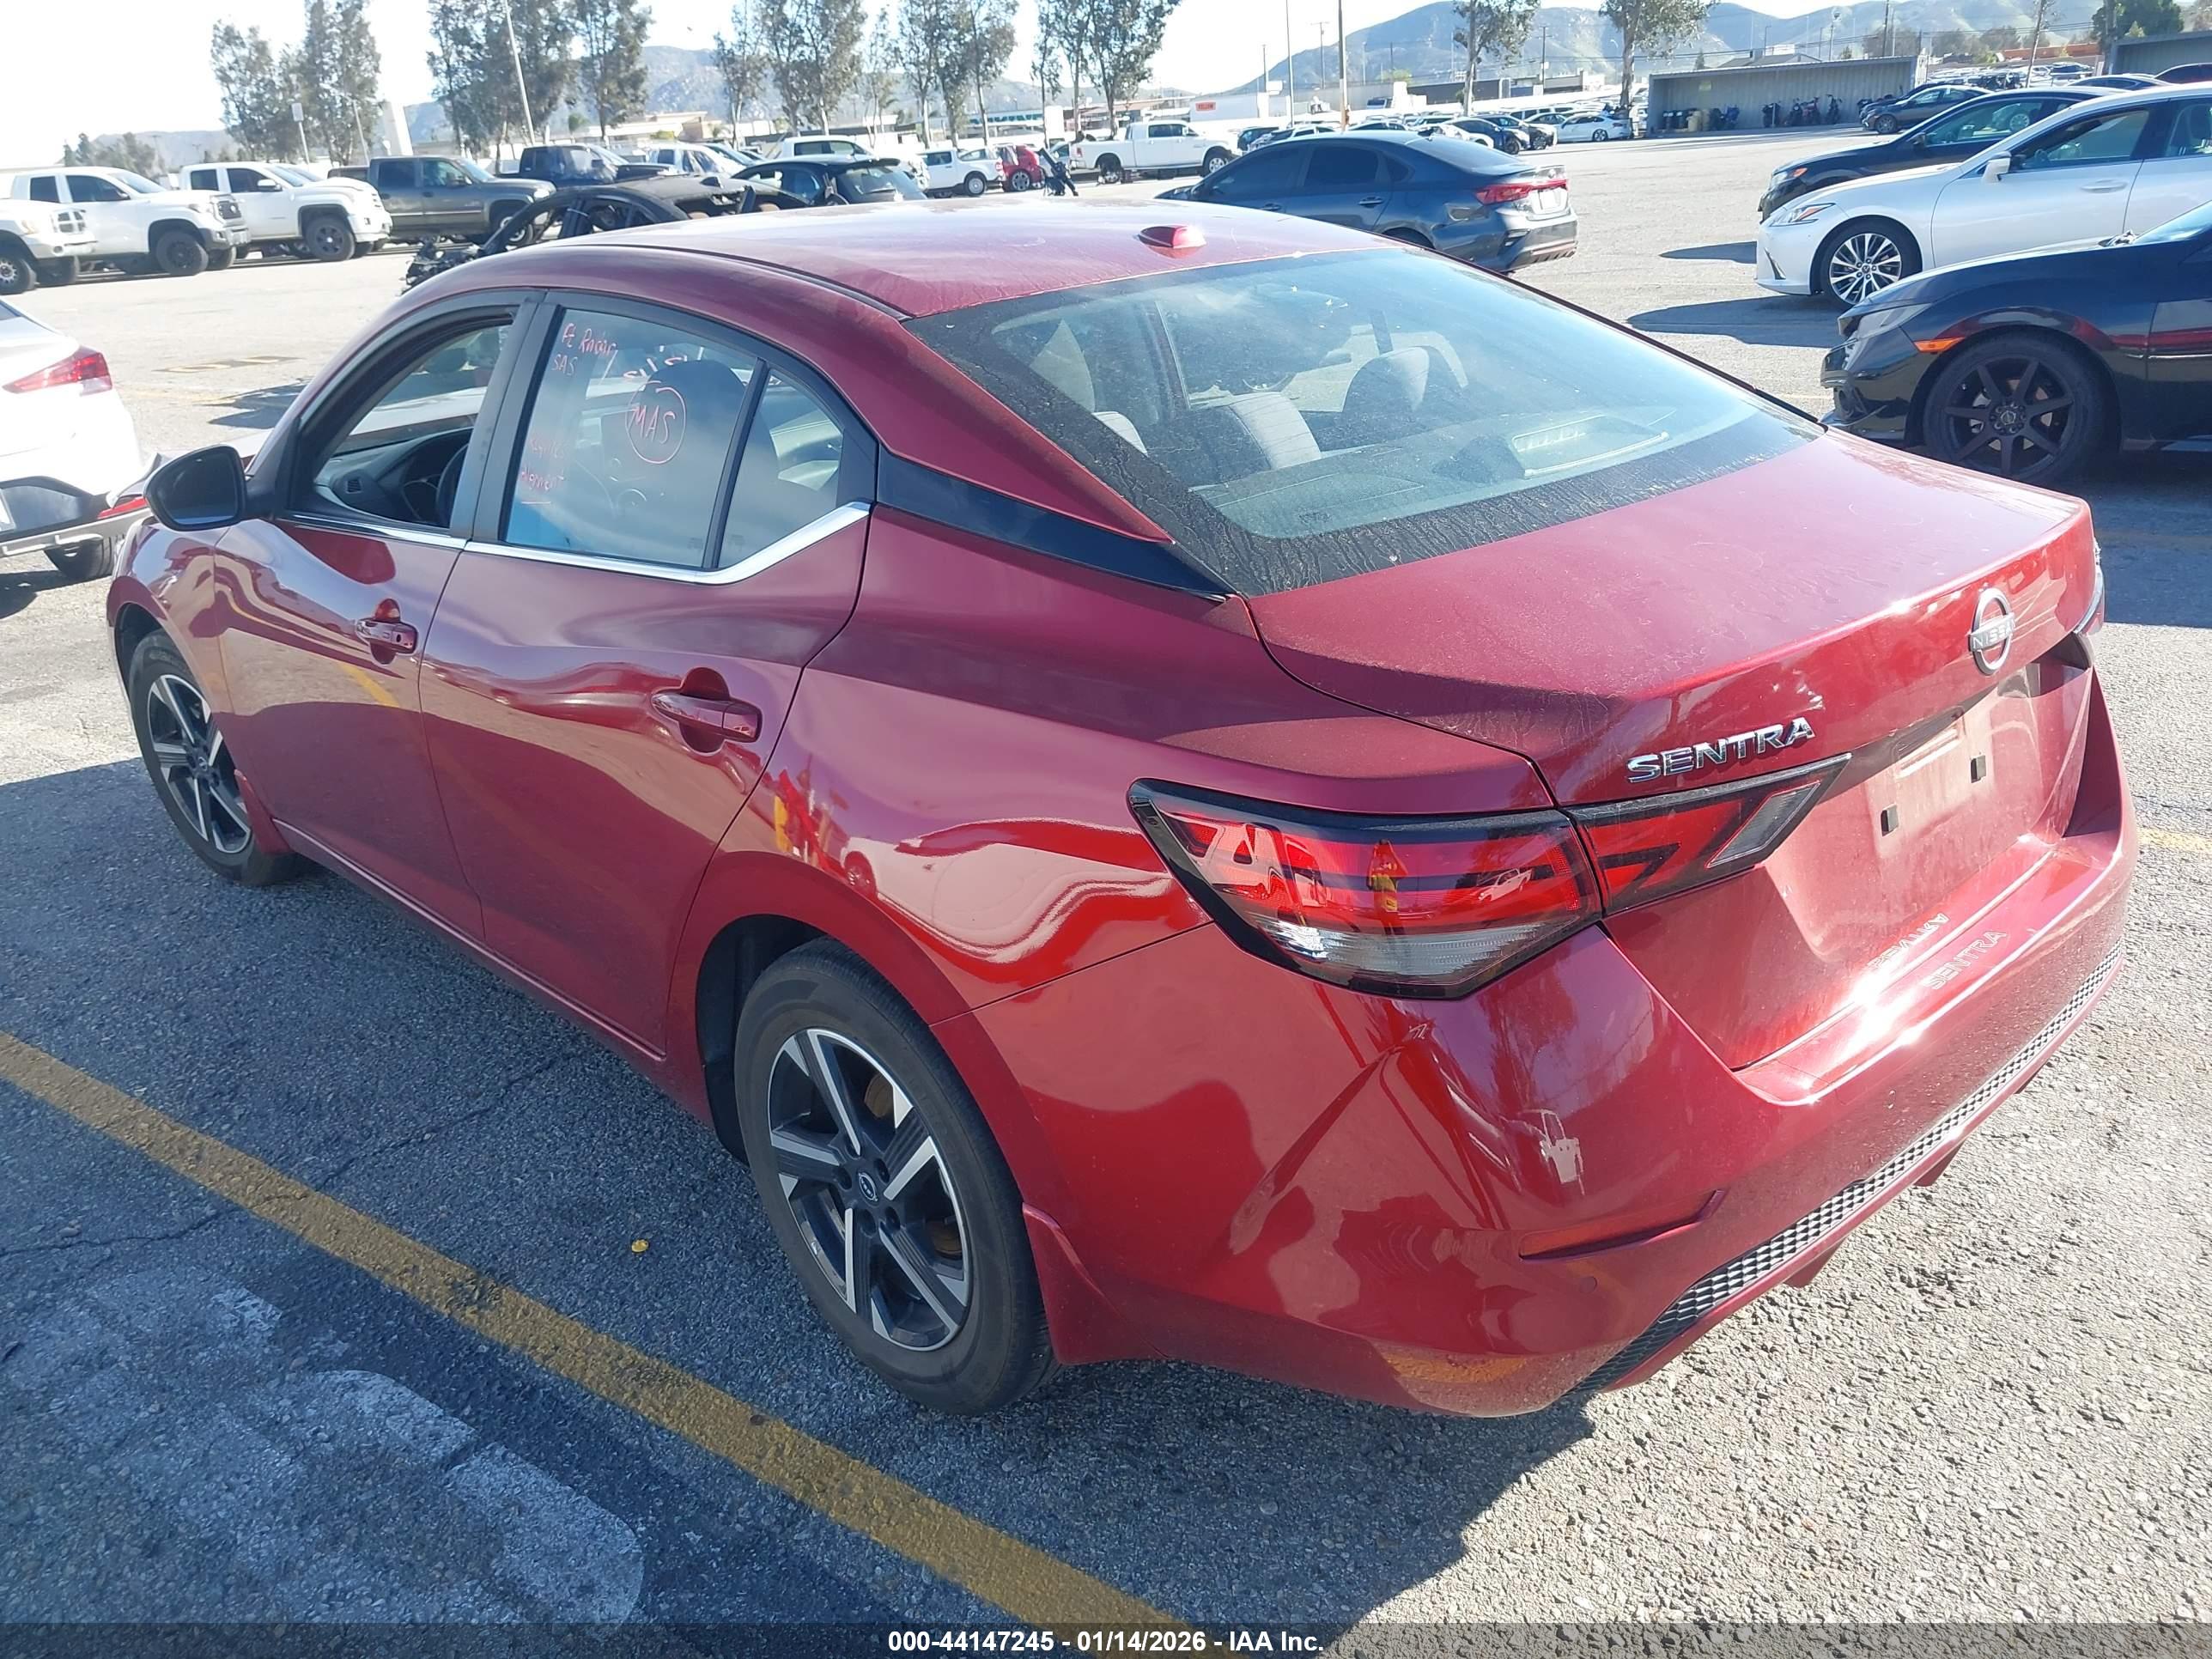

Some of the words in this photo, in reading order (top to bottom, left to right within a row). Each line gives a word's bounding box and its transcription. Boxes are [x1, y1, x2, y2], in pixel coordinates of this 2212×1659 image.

[551, 354, 578, 376] SAS
[627, 402, 677, 445] MAS
[1626, 716, 1816, 784] SENTRA
[1923, 931, 2008, 990] SENTRA
